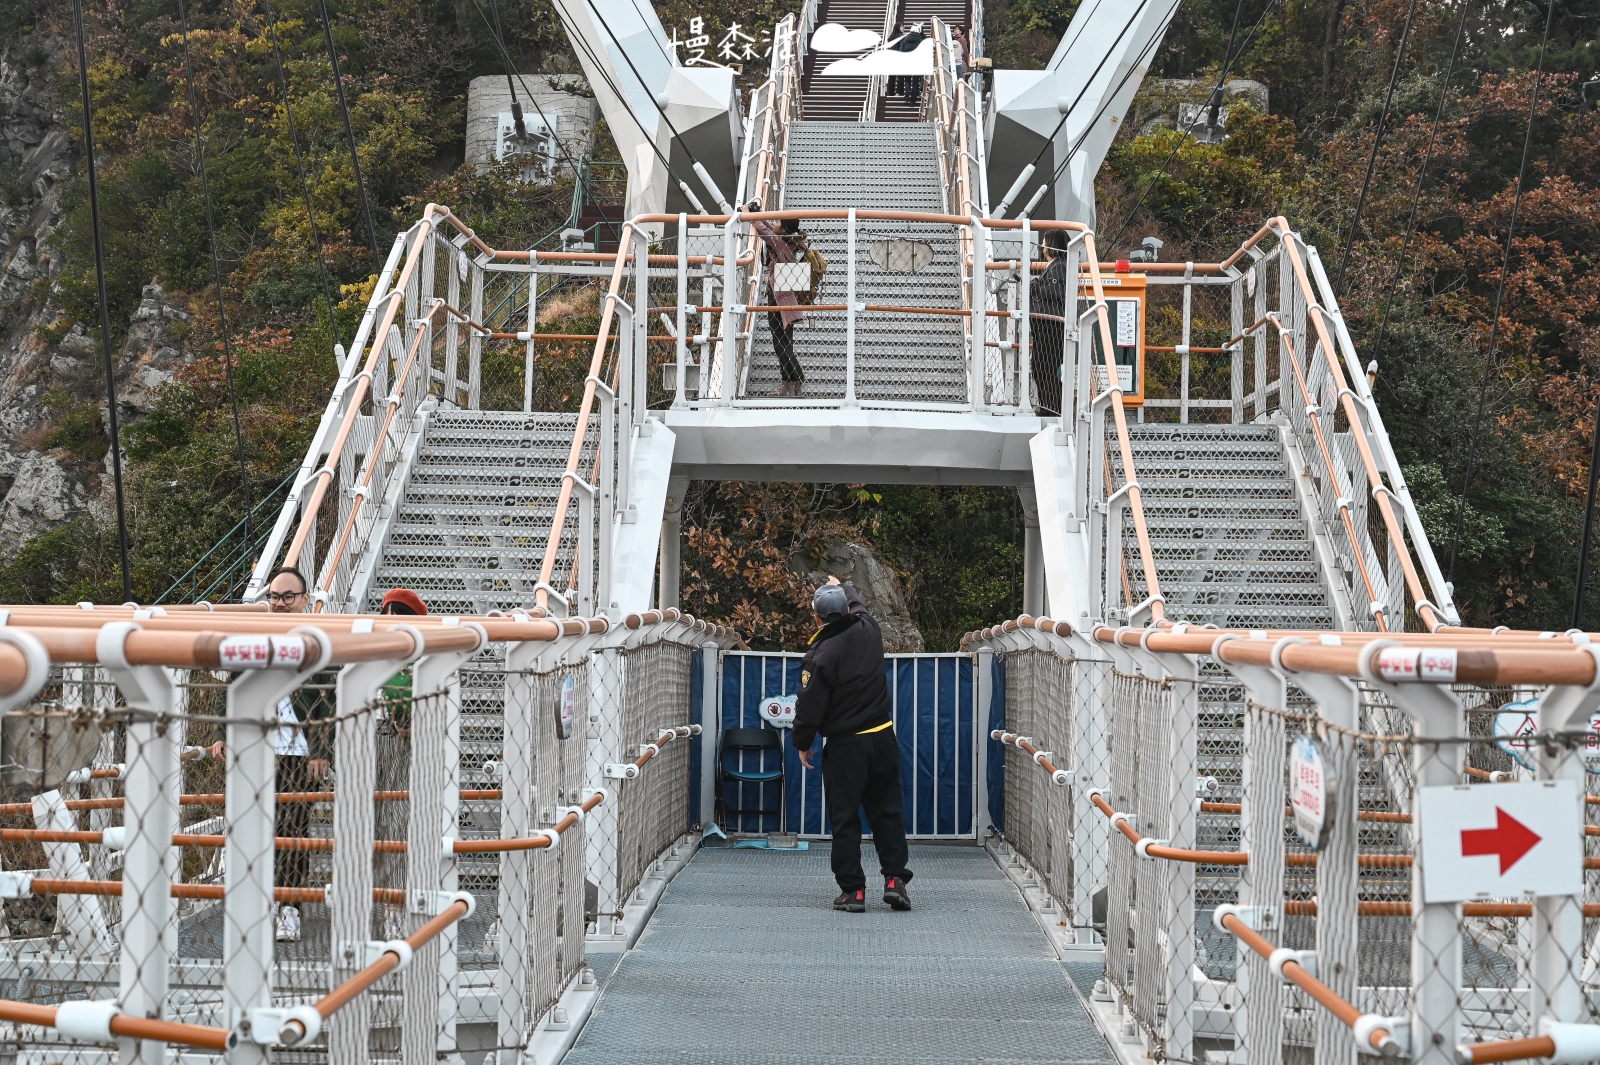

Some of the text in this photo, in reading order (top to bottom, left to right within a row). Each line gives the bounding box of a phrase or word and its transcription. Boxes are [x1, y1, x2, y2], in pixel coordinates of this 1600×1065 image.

[222, 644, 302, 662] 부딪힘 주의
[1424, 656, 1454, 674] 주의
